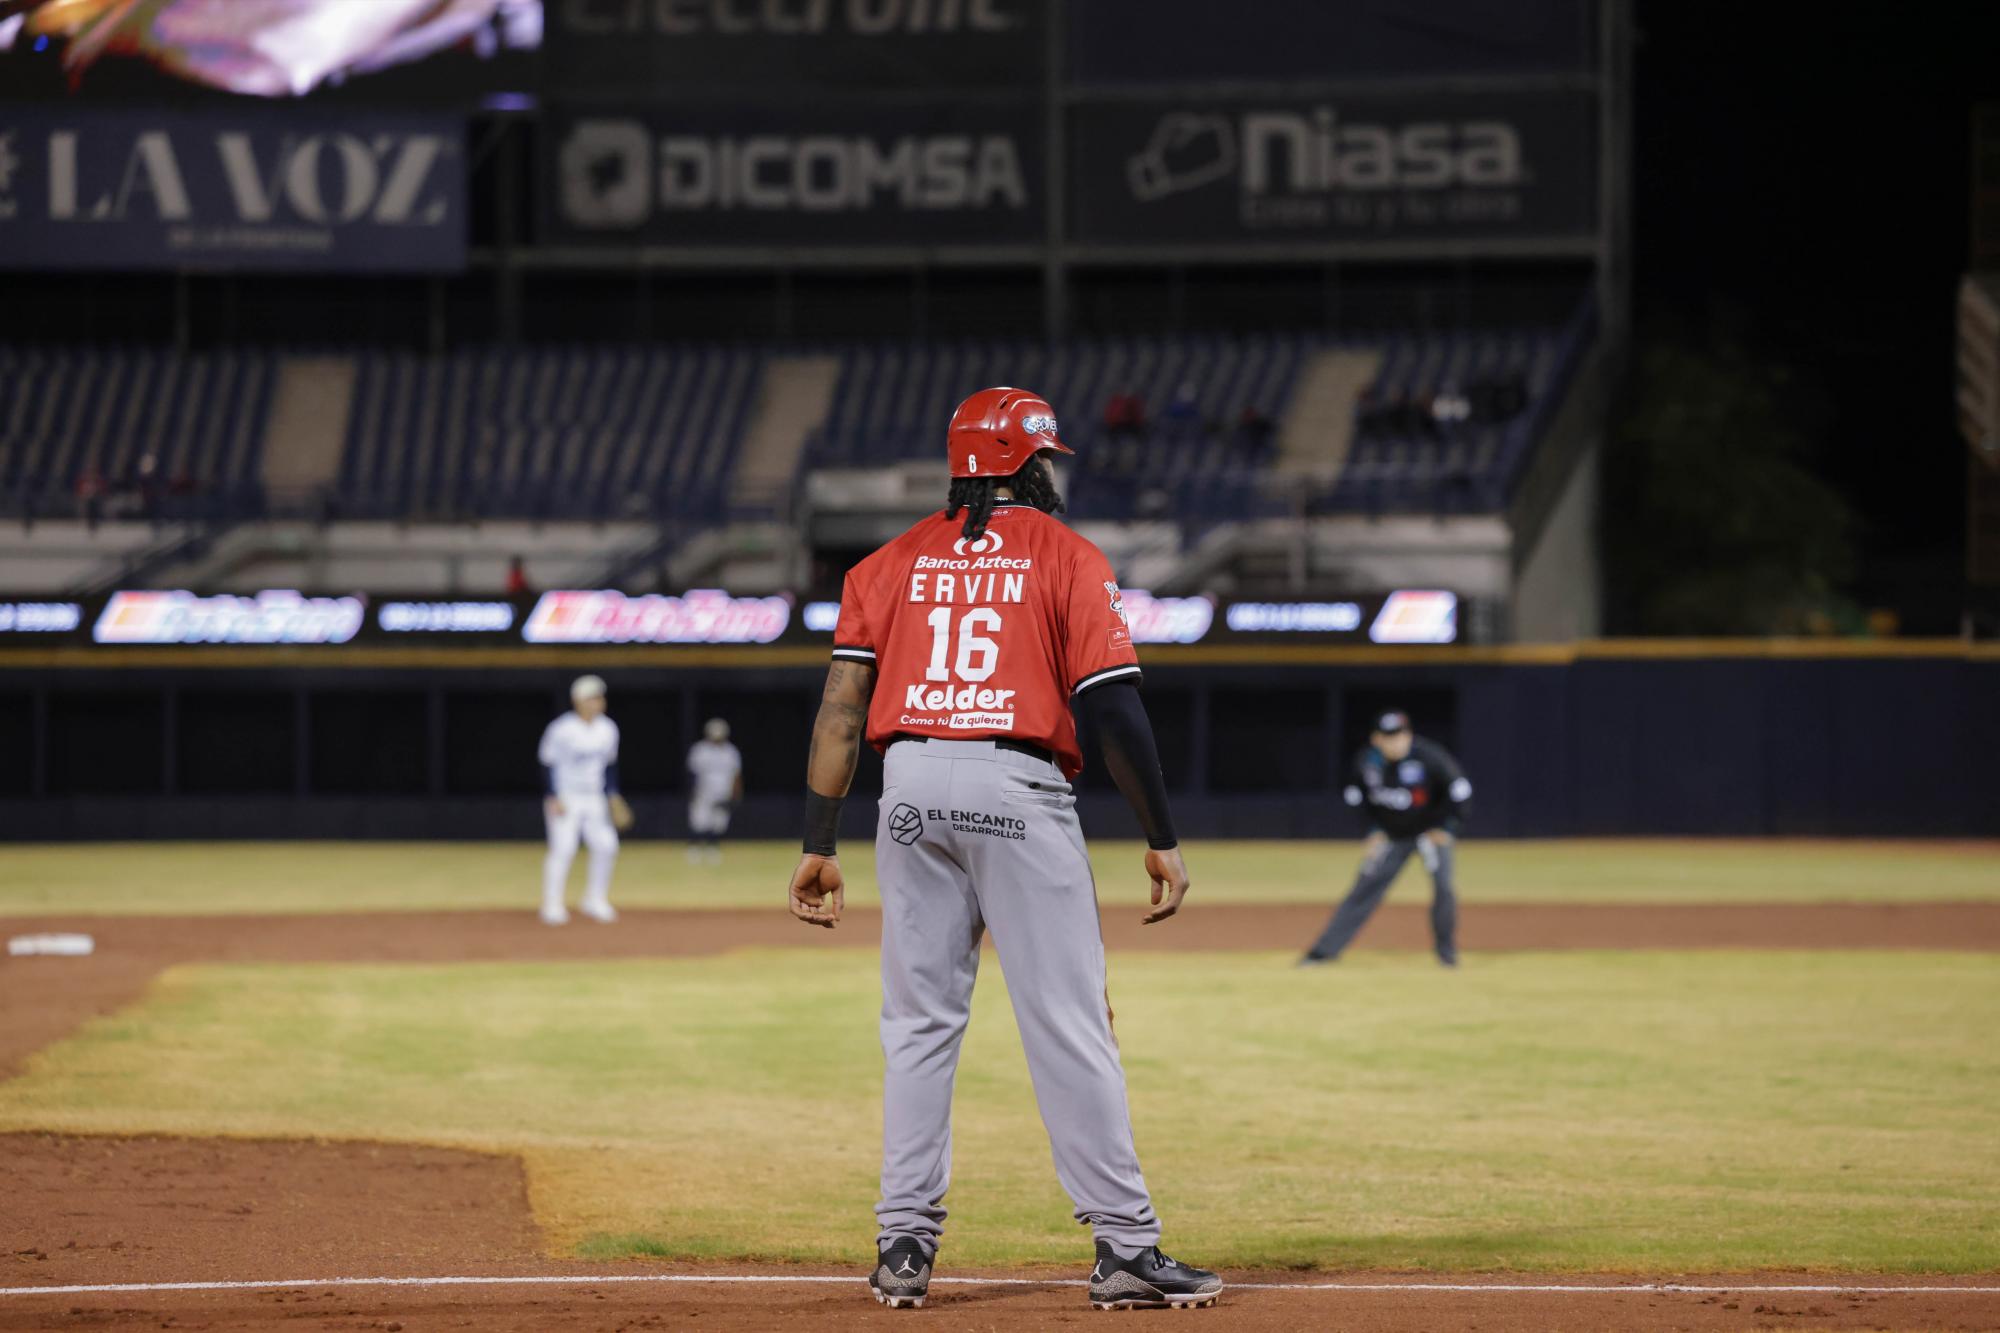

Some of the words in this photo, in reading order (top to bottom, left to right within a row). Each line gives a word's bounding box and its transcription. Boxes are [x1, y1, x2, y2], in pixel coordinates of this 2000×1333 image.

[48, 130, 191, 221] LA
[216, 131, 448, 226] VOZ
[659, 135, 1027, 209] DICOMSA
[968, 454, 977, 474] 6
[914, 555, 969, 570] Banco
[970, 555, 1032, 570] Azteca
[909, 573, 1024, 604] ERVIN
[925, 606, 1002, 682] 16
[905, 684, 1016, 711] Kelder
[900, 714, 935, 726] Como
[953, 714, 965, 726] lo
[967, 714, 1009, 728] quieres
[927, 809, 947, 821] EL
[950, 810, 1026, 831] ENCANTO
[952, 823, 1026, 841] DESARROLLOS
